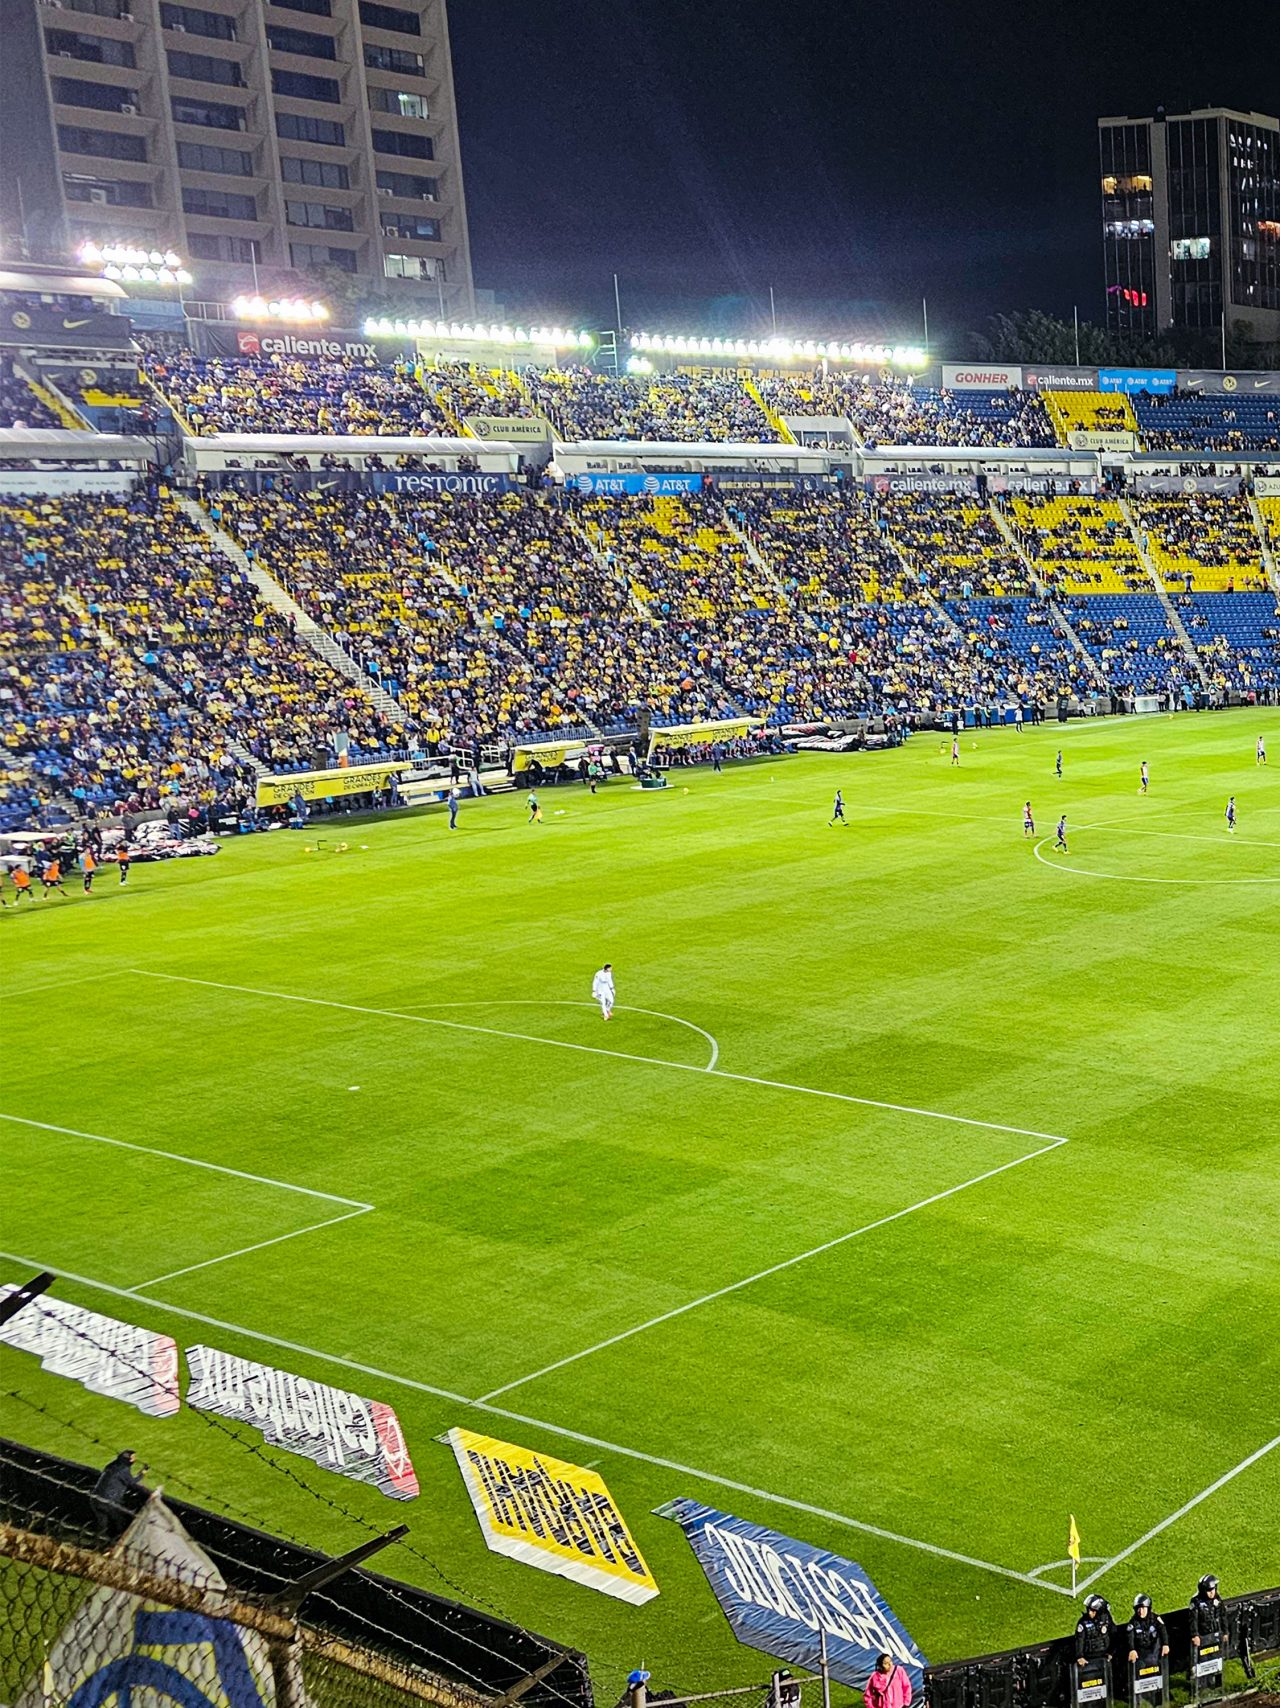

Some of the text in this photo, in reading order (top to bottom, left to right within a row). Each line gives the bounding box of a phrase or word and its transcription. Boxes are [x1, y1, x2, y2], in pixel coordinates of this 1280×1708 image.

[261, 336, 377, 358] caliente.mx
[955, 372, 1008, 384] GONHER
[1037, 375, 1094, 386] caliente.mx
[492, 425, 510, 433] CLUB
[595, 479, 625, 491] AT&T
[661, 479, 691, 491] AT&T
[890, 477, 971, 492] caliente.mx
[343, 773, 382, 785] GRANDES
[466, 1449, 646, 1577] BARDAHL
